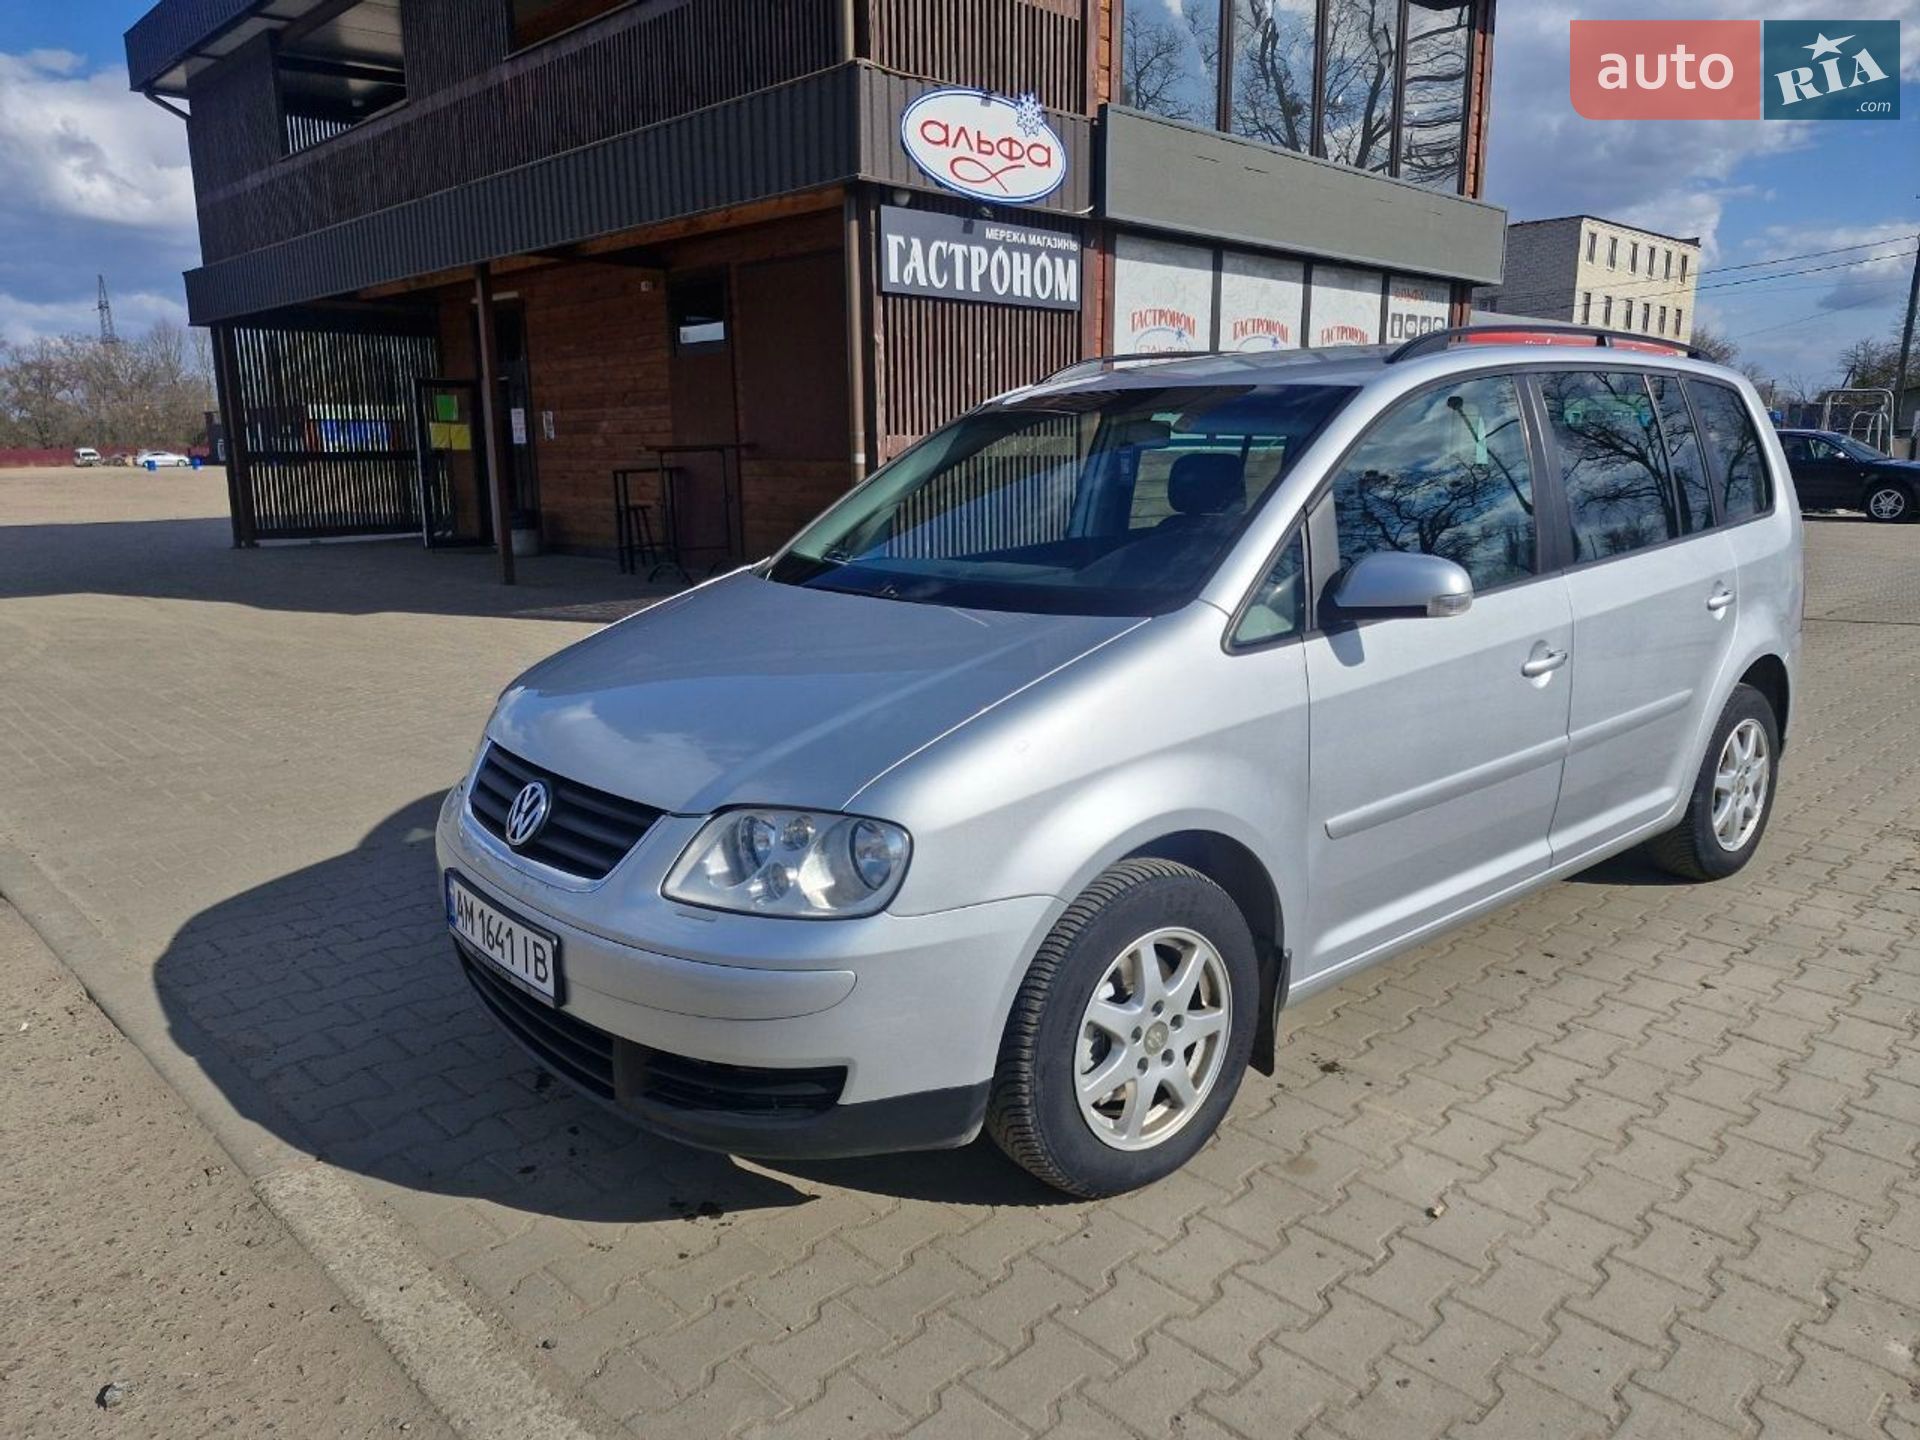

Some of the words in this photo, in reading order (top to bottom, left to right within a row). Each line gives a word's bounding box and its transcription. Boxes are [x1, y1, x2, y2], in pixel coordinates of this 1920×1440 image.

[886, 233, 1078, 302] ГАСТРОНОМ
[985, 227, 1026, 244] МЕРЕЖА
[456, 890, 475, 936] AM
[478, 908, 515, 966] 1641
[523, 936, 549, 984] IB
